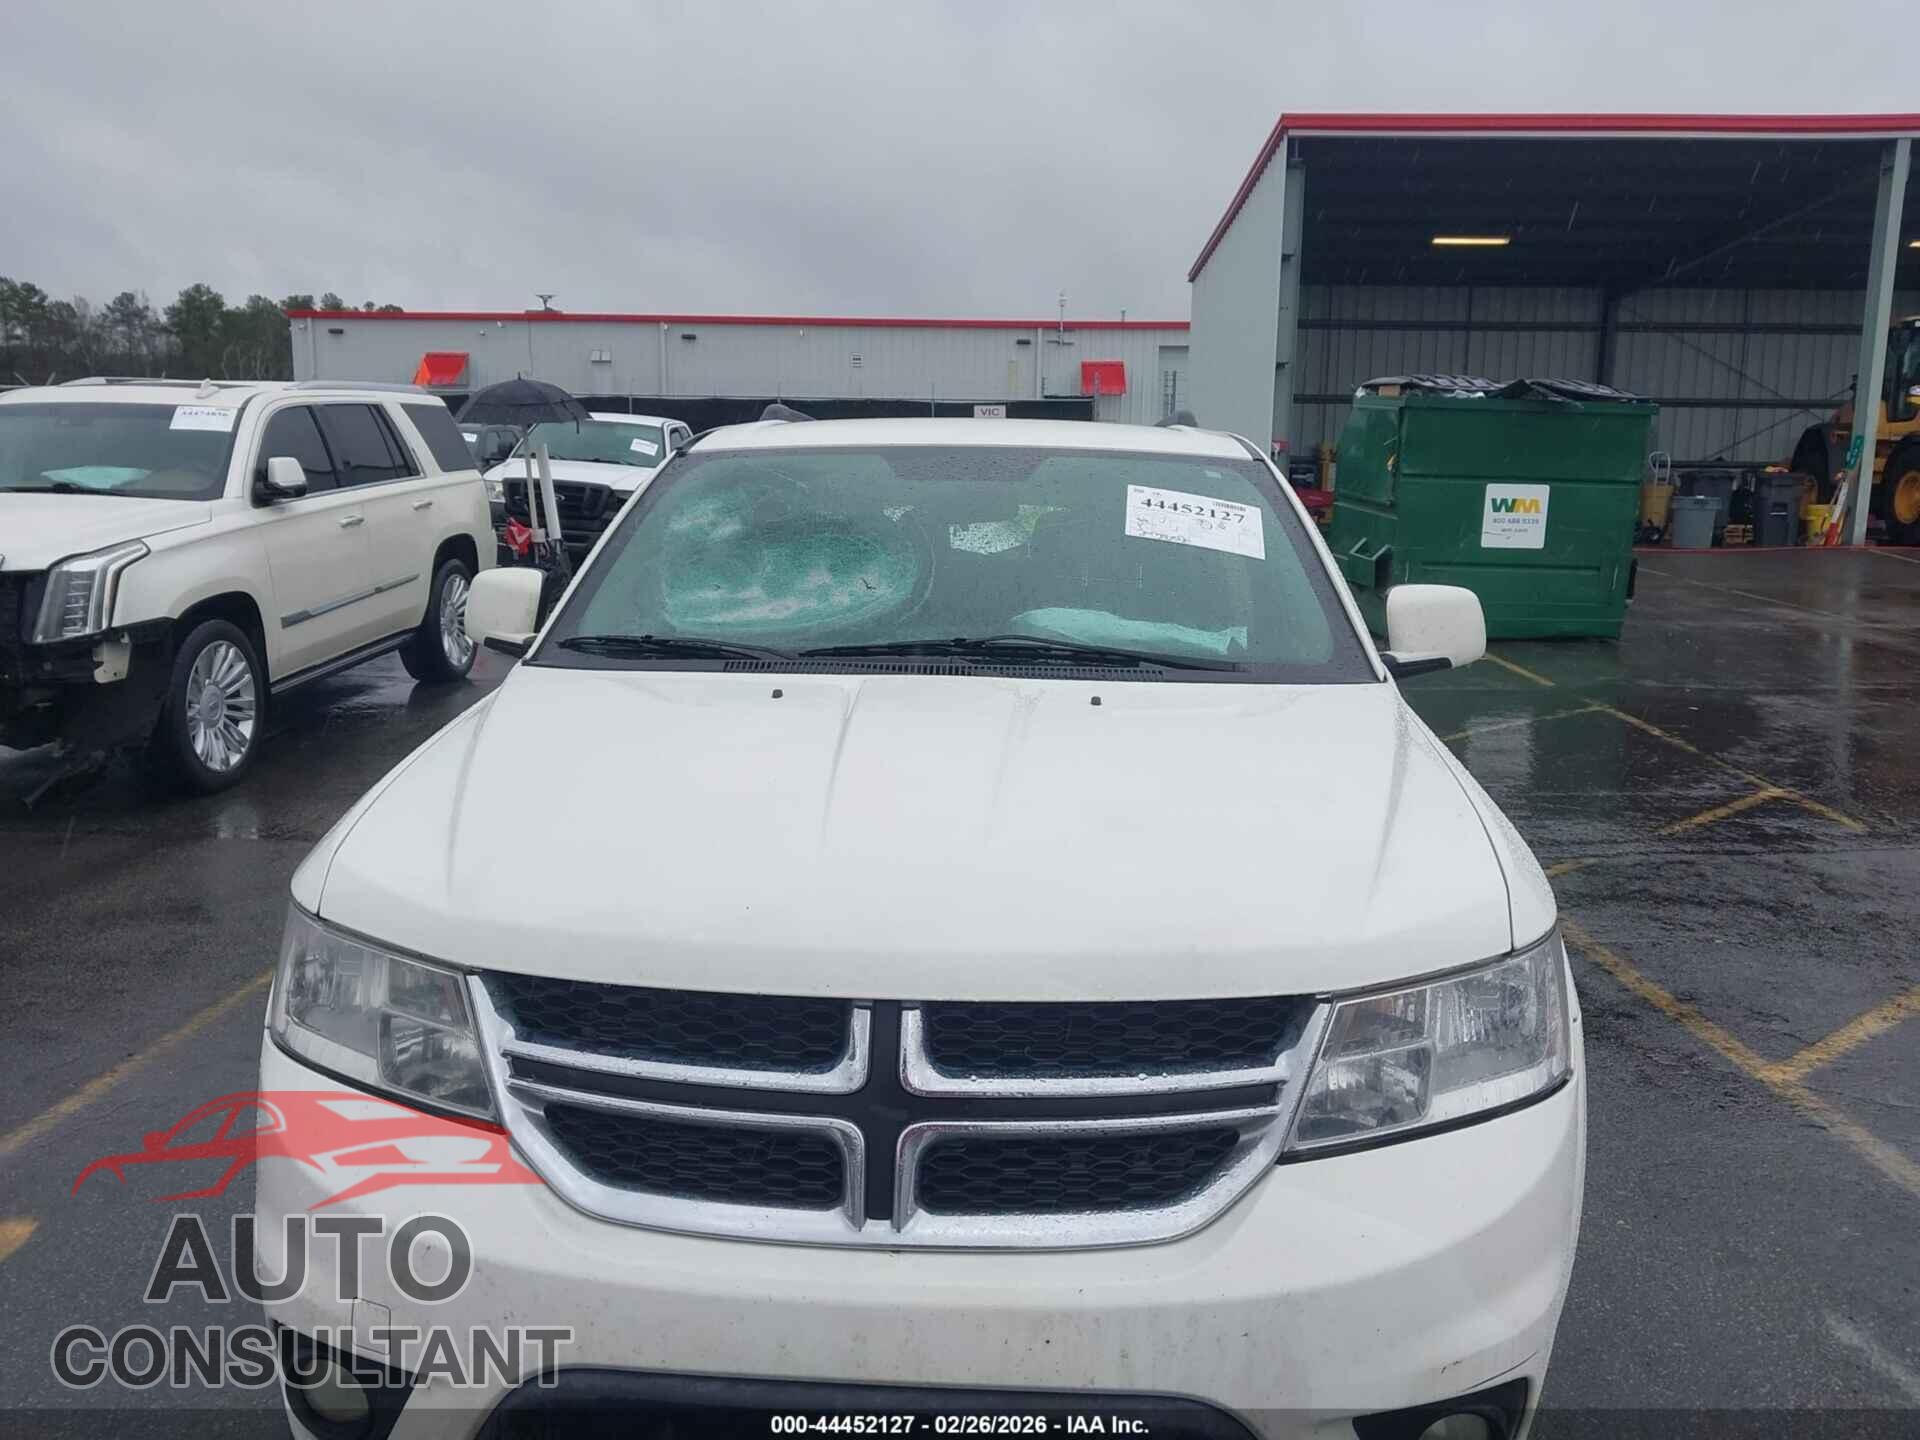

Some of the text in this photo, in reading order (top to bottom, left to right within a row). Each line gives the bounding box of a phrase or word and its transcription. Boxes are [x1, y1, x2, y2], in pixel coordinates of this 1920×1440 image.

[980, 407, 1001, 417] VIC
[1141, 498, 1246, 524] 44452127
[1491, 497, 1541, 513] WM
